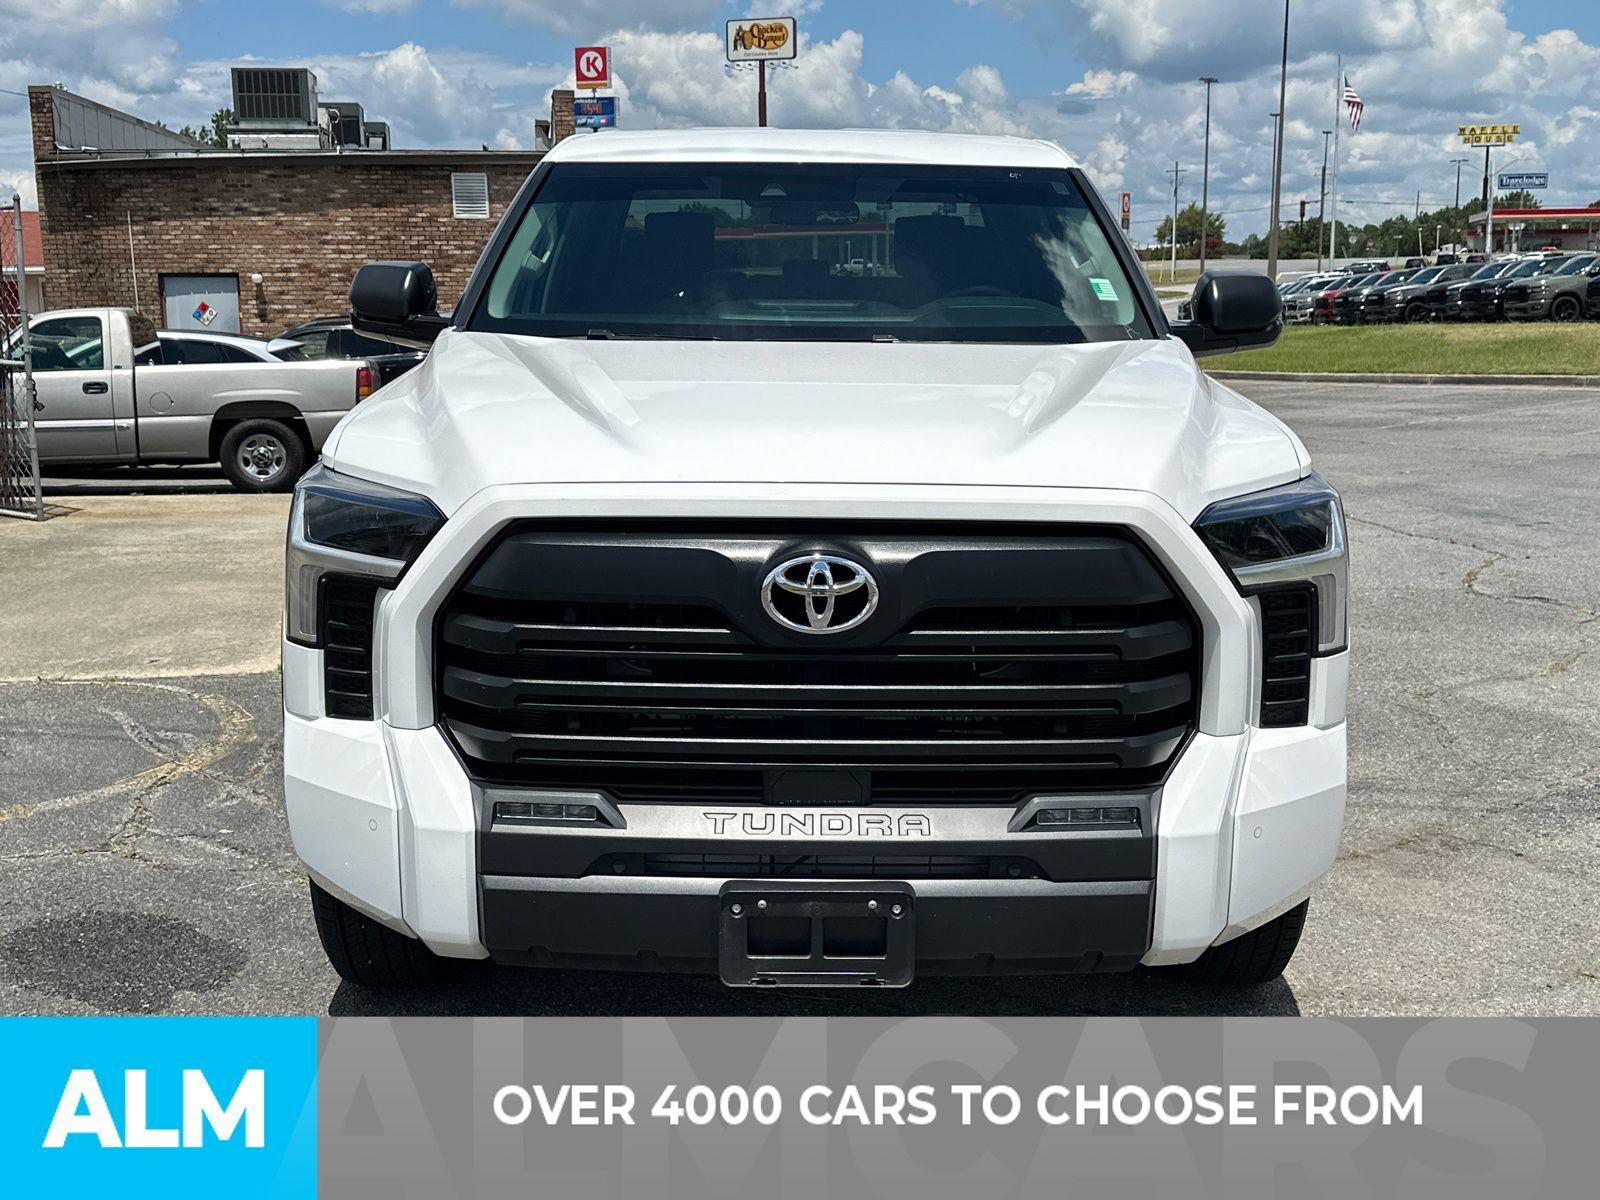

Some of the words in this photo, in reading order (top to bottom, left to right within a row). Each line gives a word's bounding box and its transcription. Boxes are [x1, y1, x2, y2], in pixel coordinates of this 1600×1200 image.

[750, 23, 783, 38] Cracker
[758, 33, 786, 48] Barrel
[586, 56, 600, 73] K
[1458, 125, 1520, 134] WAFFLE
[1464, 134, 1514, 143] HOUSE
[1501, 175, 1545, 185] Travelodge
[703, 813, 931, 836] TUNDRA
